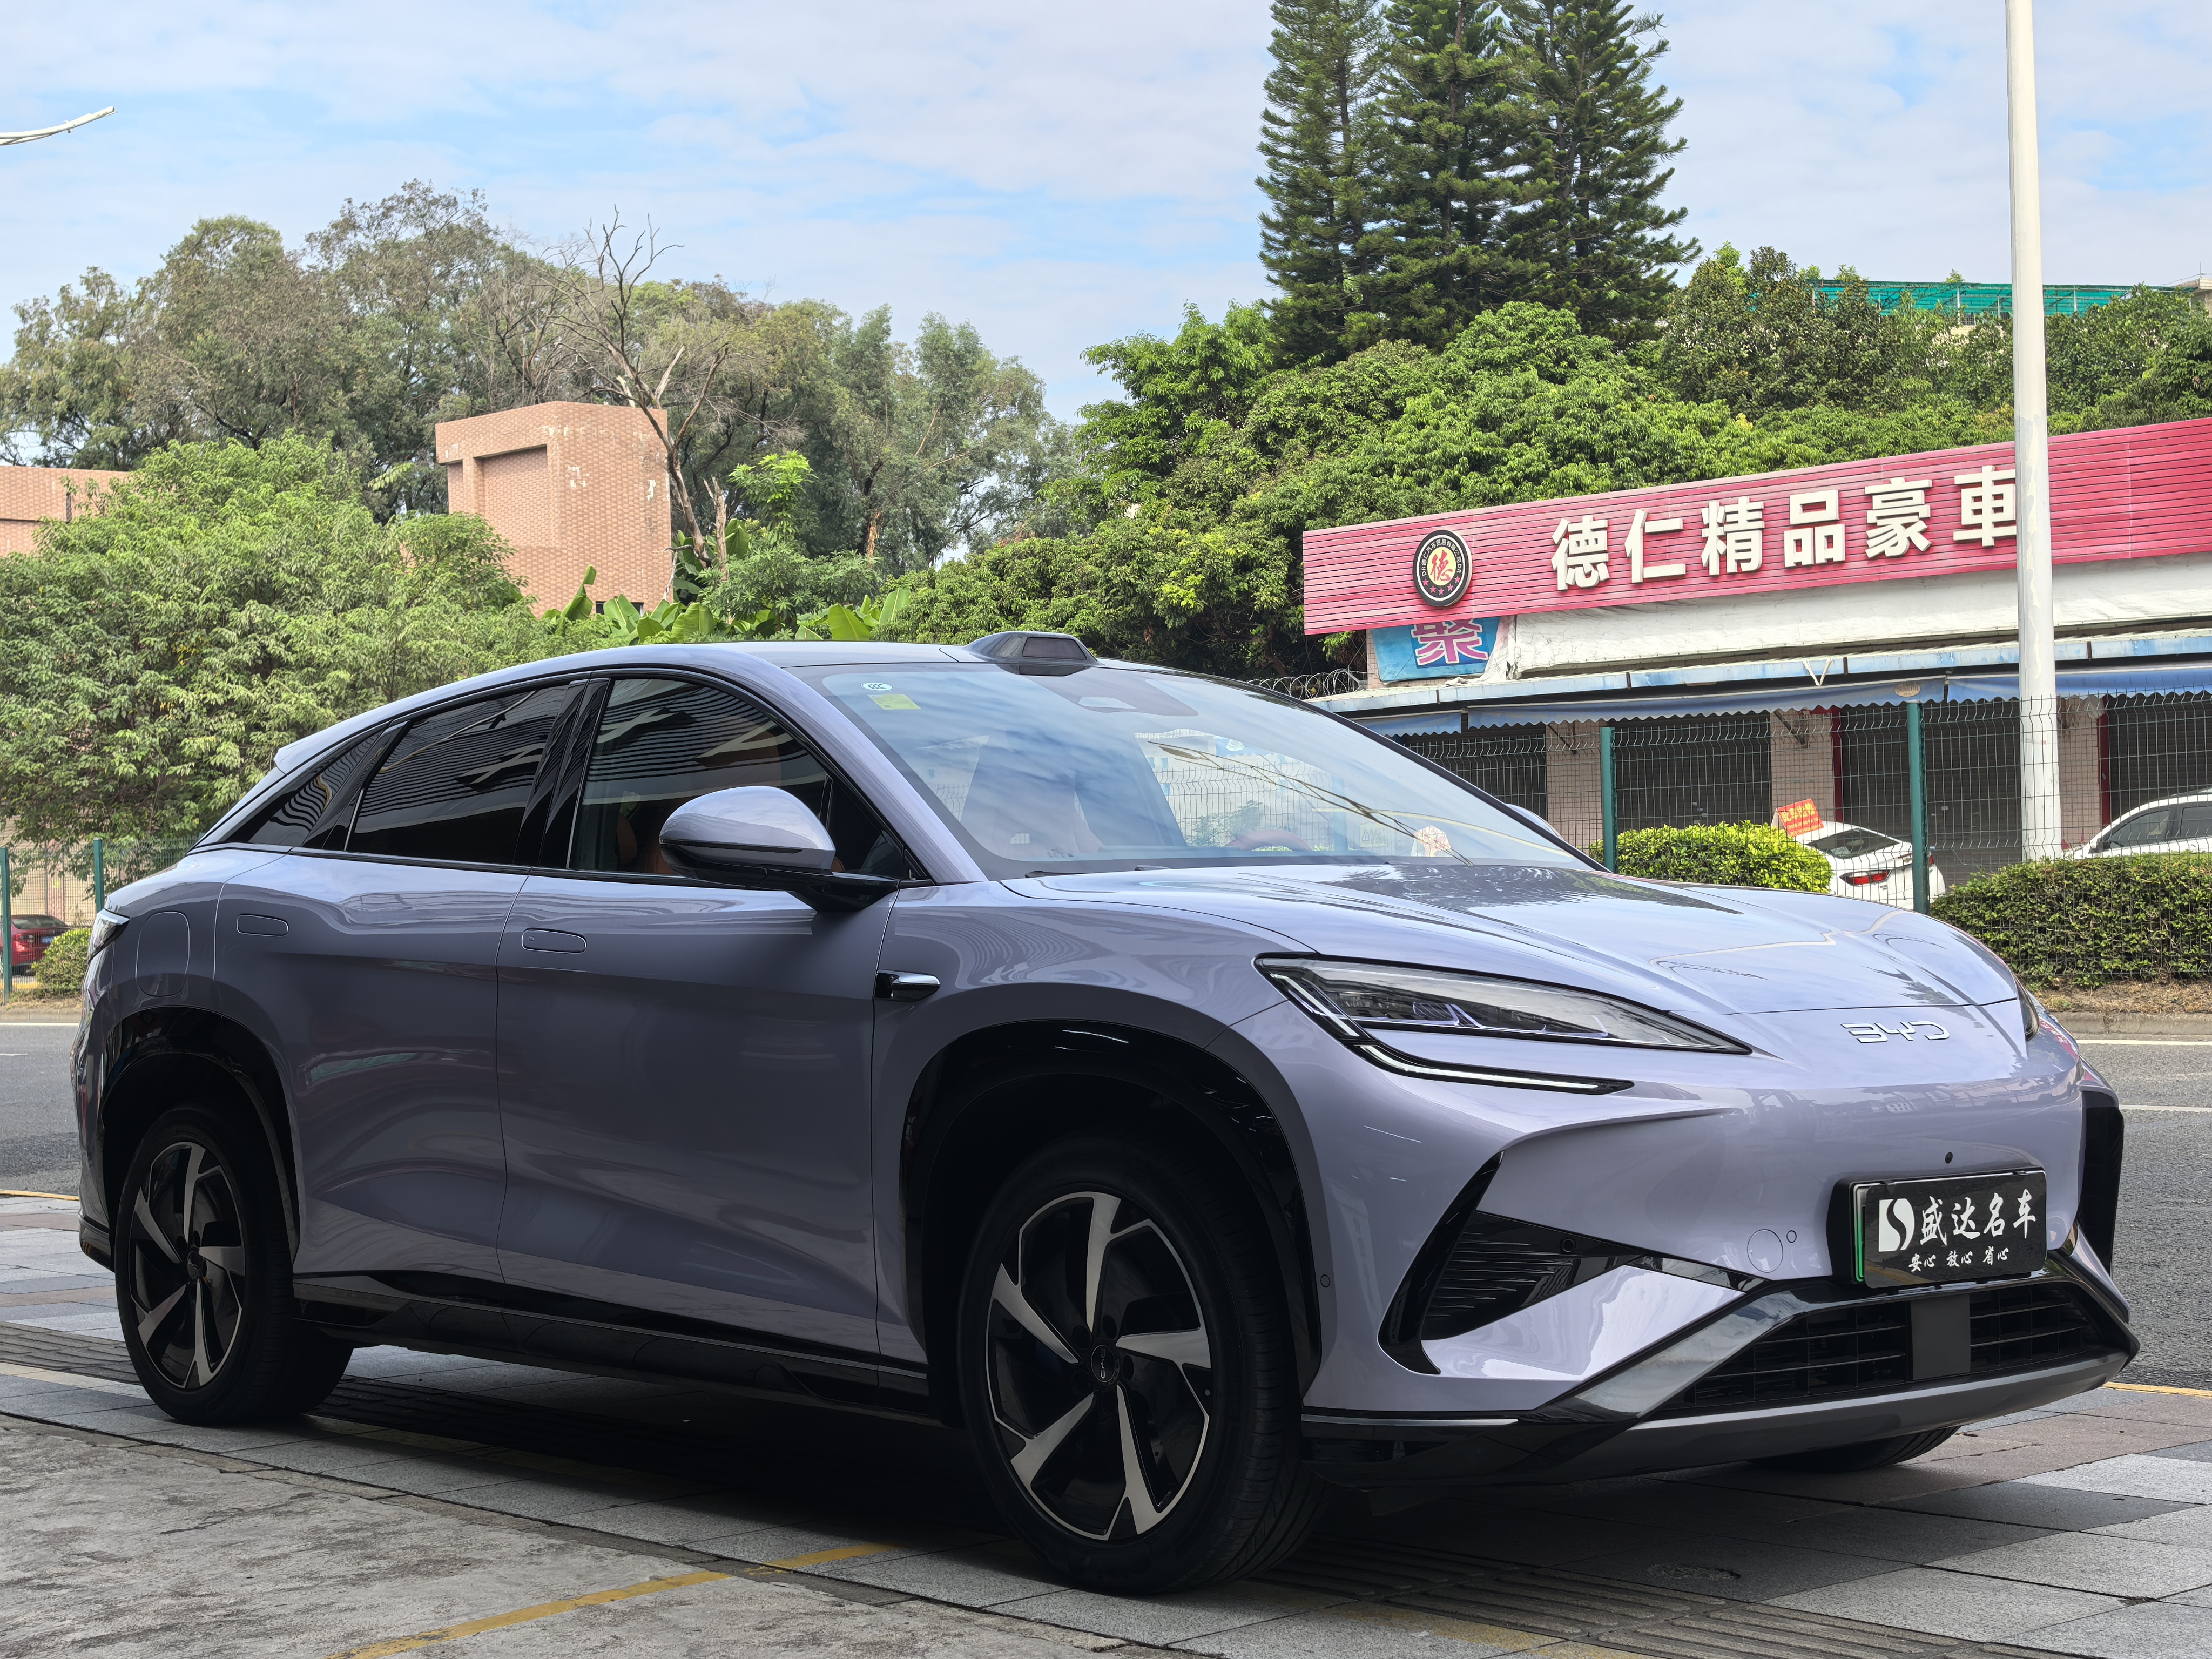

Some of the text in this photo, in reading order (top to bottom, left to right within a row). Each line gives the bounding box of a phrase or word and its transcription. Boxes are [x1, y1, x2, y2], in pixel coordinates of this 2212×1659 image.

[1551, 466, 2017, 591] 德仁精品豪車
[1840, 1020, 1950, 1043] BYD
[1920, 1189, 2036, 1246] 盛达名车
[1946, 1250, 1973, 1267] 放心
[1982, 1246, 2009, 1265] 省心
